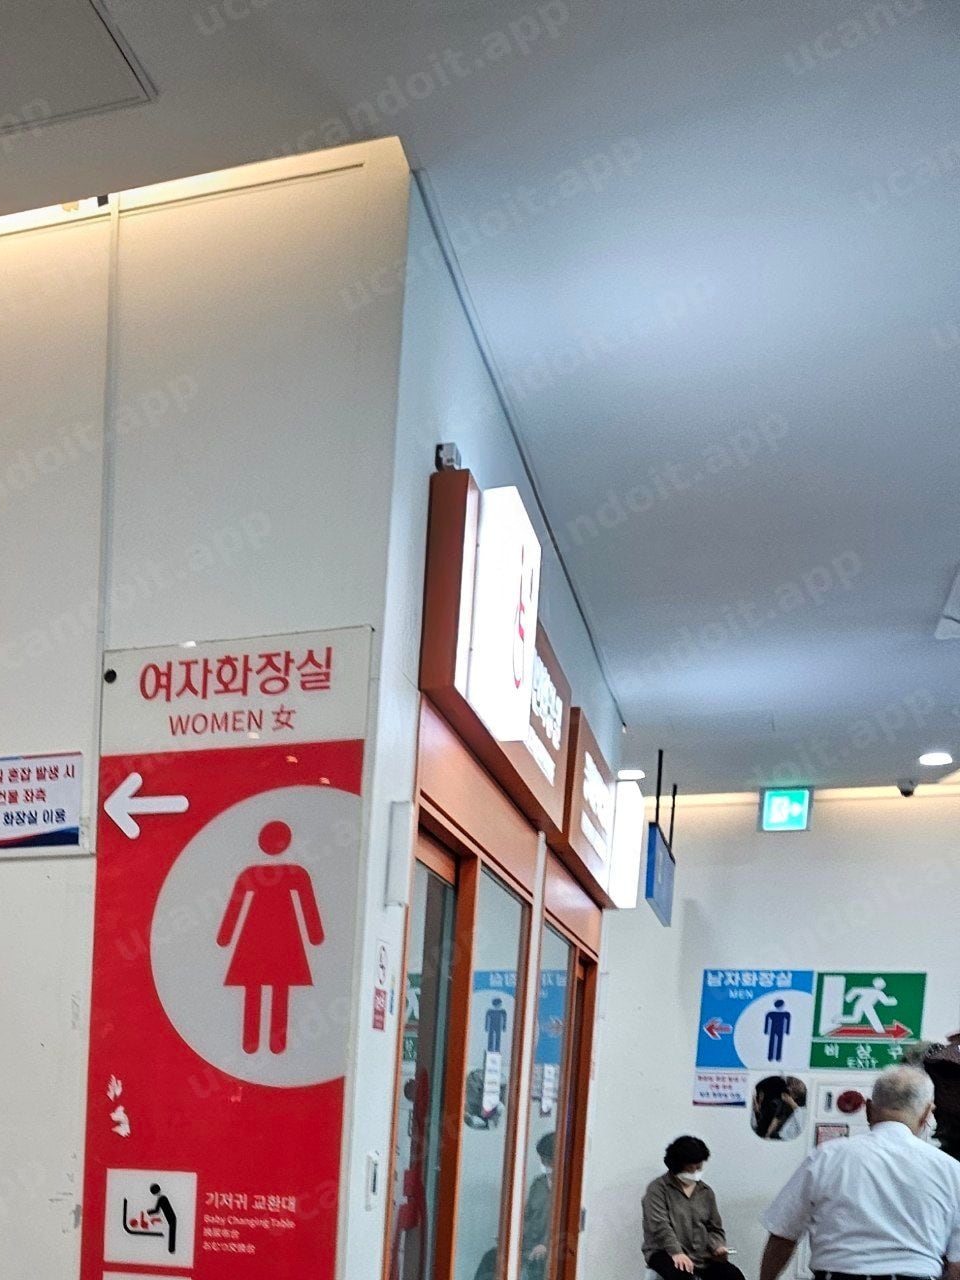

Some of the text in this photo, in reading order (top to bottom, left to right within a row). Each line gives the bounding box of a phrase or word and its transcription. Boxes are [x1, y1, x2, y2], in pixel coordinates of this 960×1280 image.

[139, 647, 333, 702] 여자화장실
[169, 704, 296, 736] WOMEN 女
[8, 766, 31, 782] 혼잡
[36, 765, 59, 781] 발생
[64, 763, 75, 778] 시
[23, 787, 47, 803] 좌측
[3, 810, 38, 826] 화장실
[43, 808, 66, 823] 이용
[707, 971, 792, 988] 남자화장실
[728, 989, 754, 1000] MEN
[847, 1057, 879, 1069] EXIT
[205, 1191, 296, 1213] 기저귀 교환대
